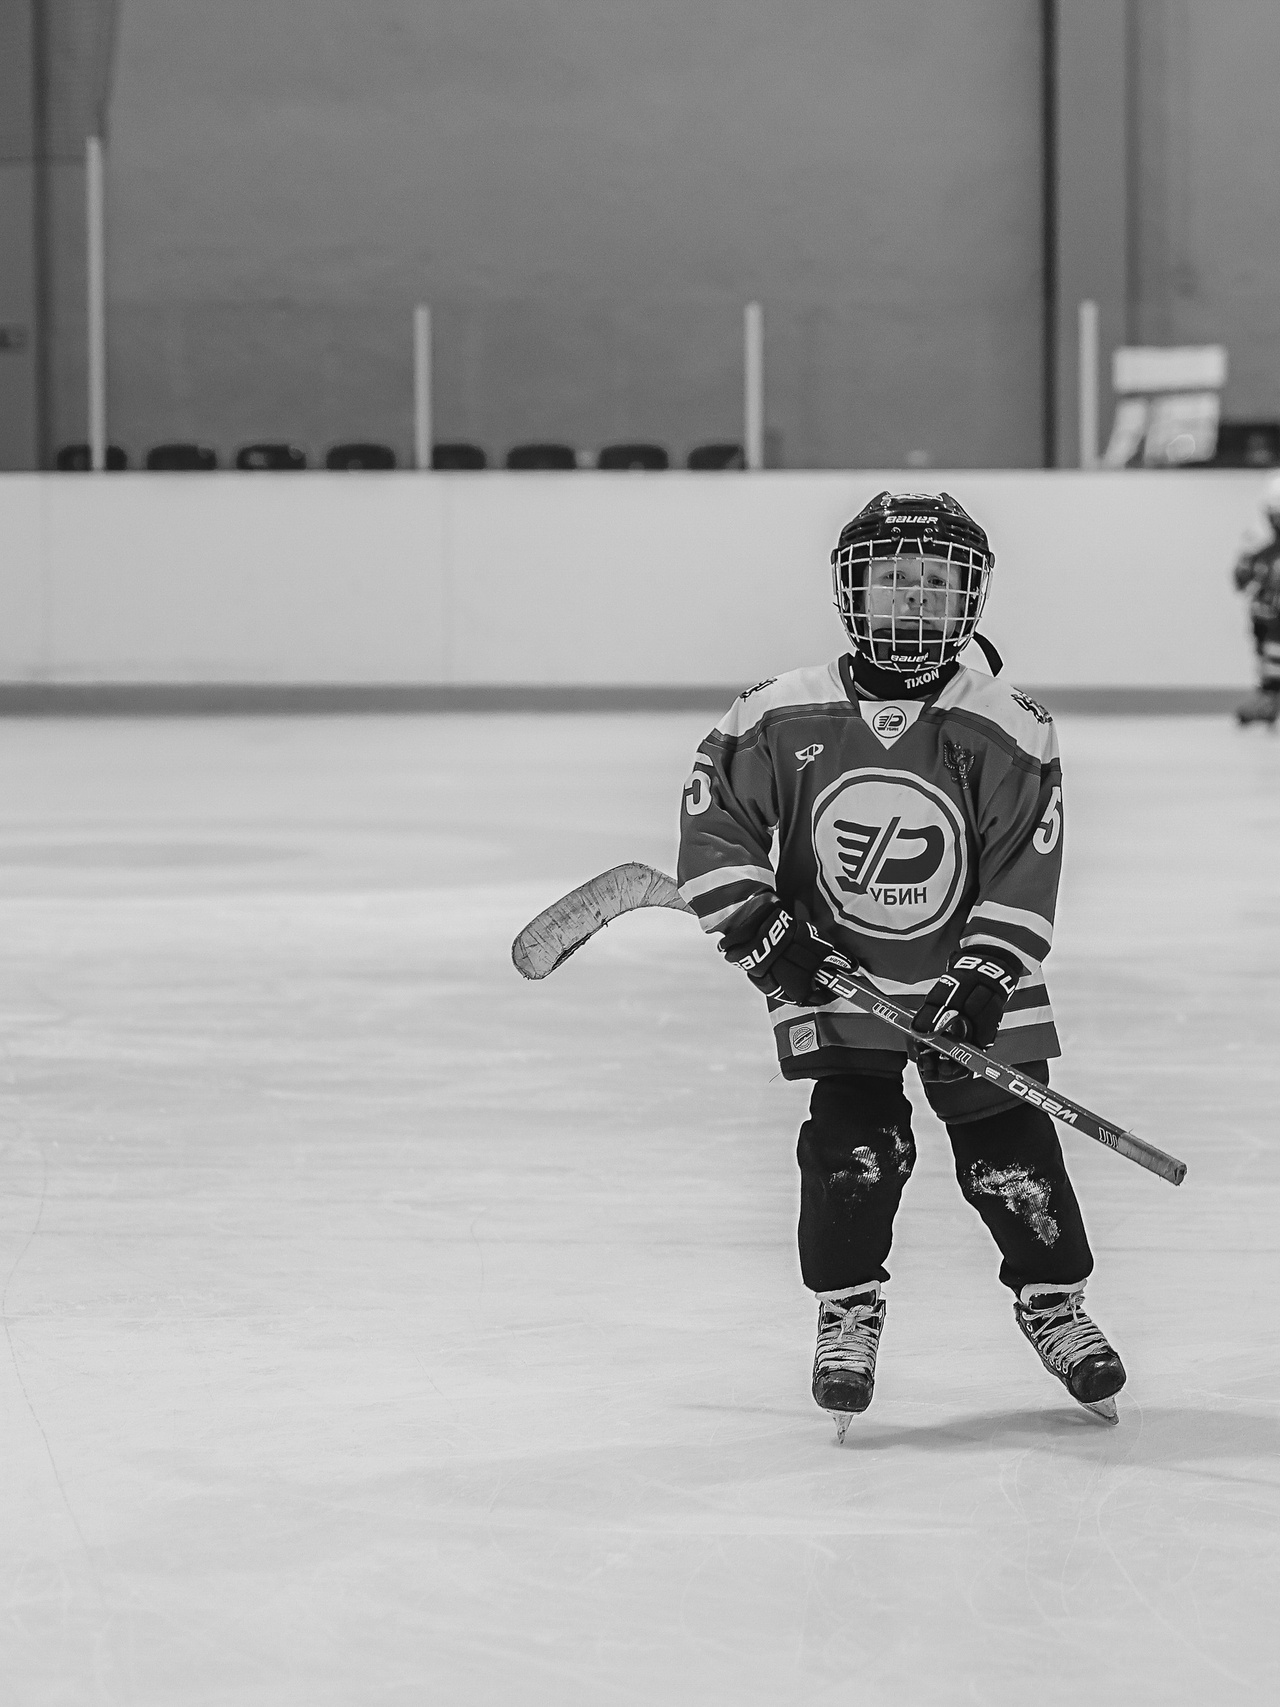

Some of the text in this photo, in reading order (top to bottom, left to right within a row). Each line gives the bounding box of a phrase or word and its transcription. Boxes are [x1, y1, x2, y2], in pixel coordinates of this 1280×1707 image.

[884, 515, 939, 524] BAUER
[904, 668, 940, 689] TIXON
[1033, 786, 1062, 855] 5
[869, 886, 927, 906] УБИН
[738, 909, 794, 970] AUER
[953, 956, 1016, 995] BAU
